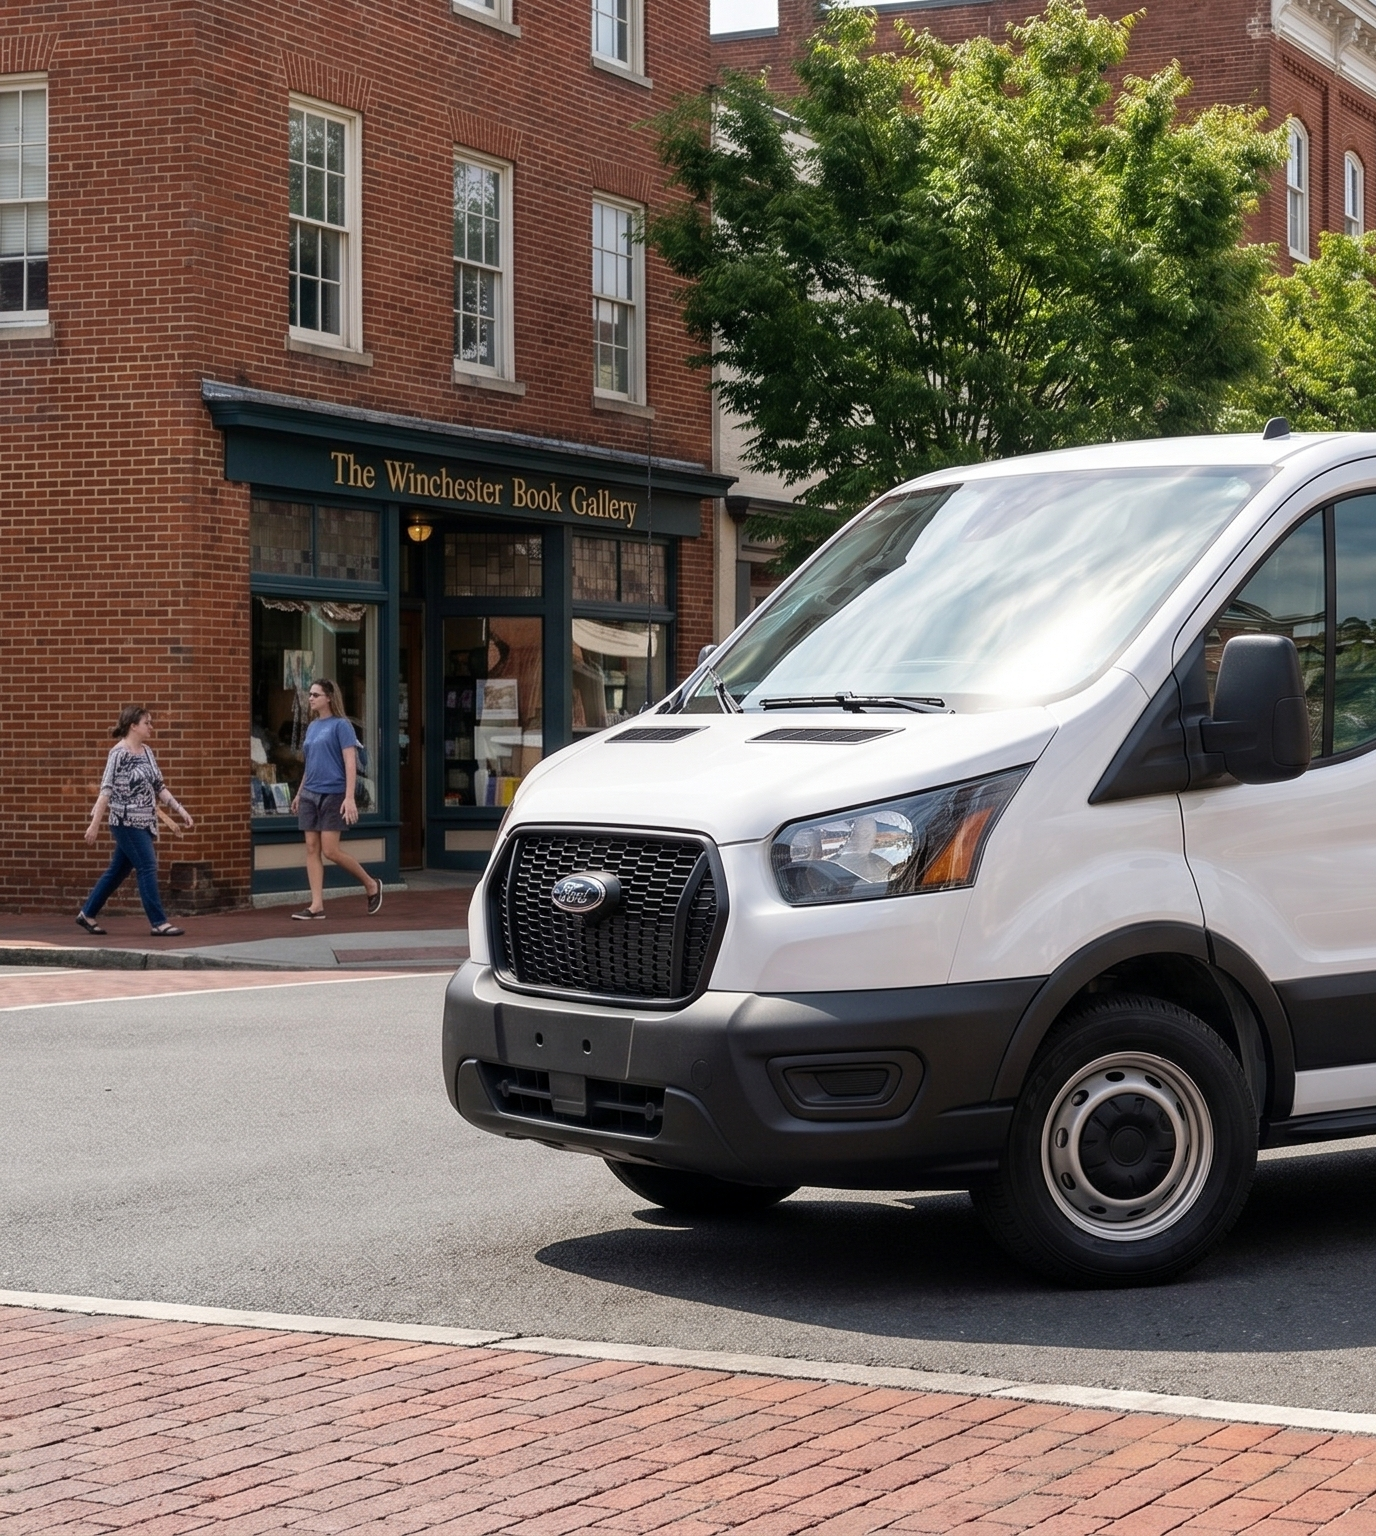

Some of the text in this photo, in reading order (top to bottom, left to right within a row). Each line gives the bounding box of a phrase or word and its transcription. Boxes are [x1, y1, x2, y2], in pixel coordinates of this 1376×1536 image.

[331, 451, 637, 528] The Winchester Book Gallery
[558, 881, 592, 904] Ford
